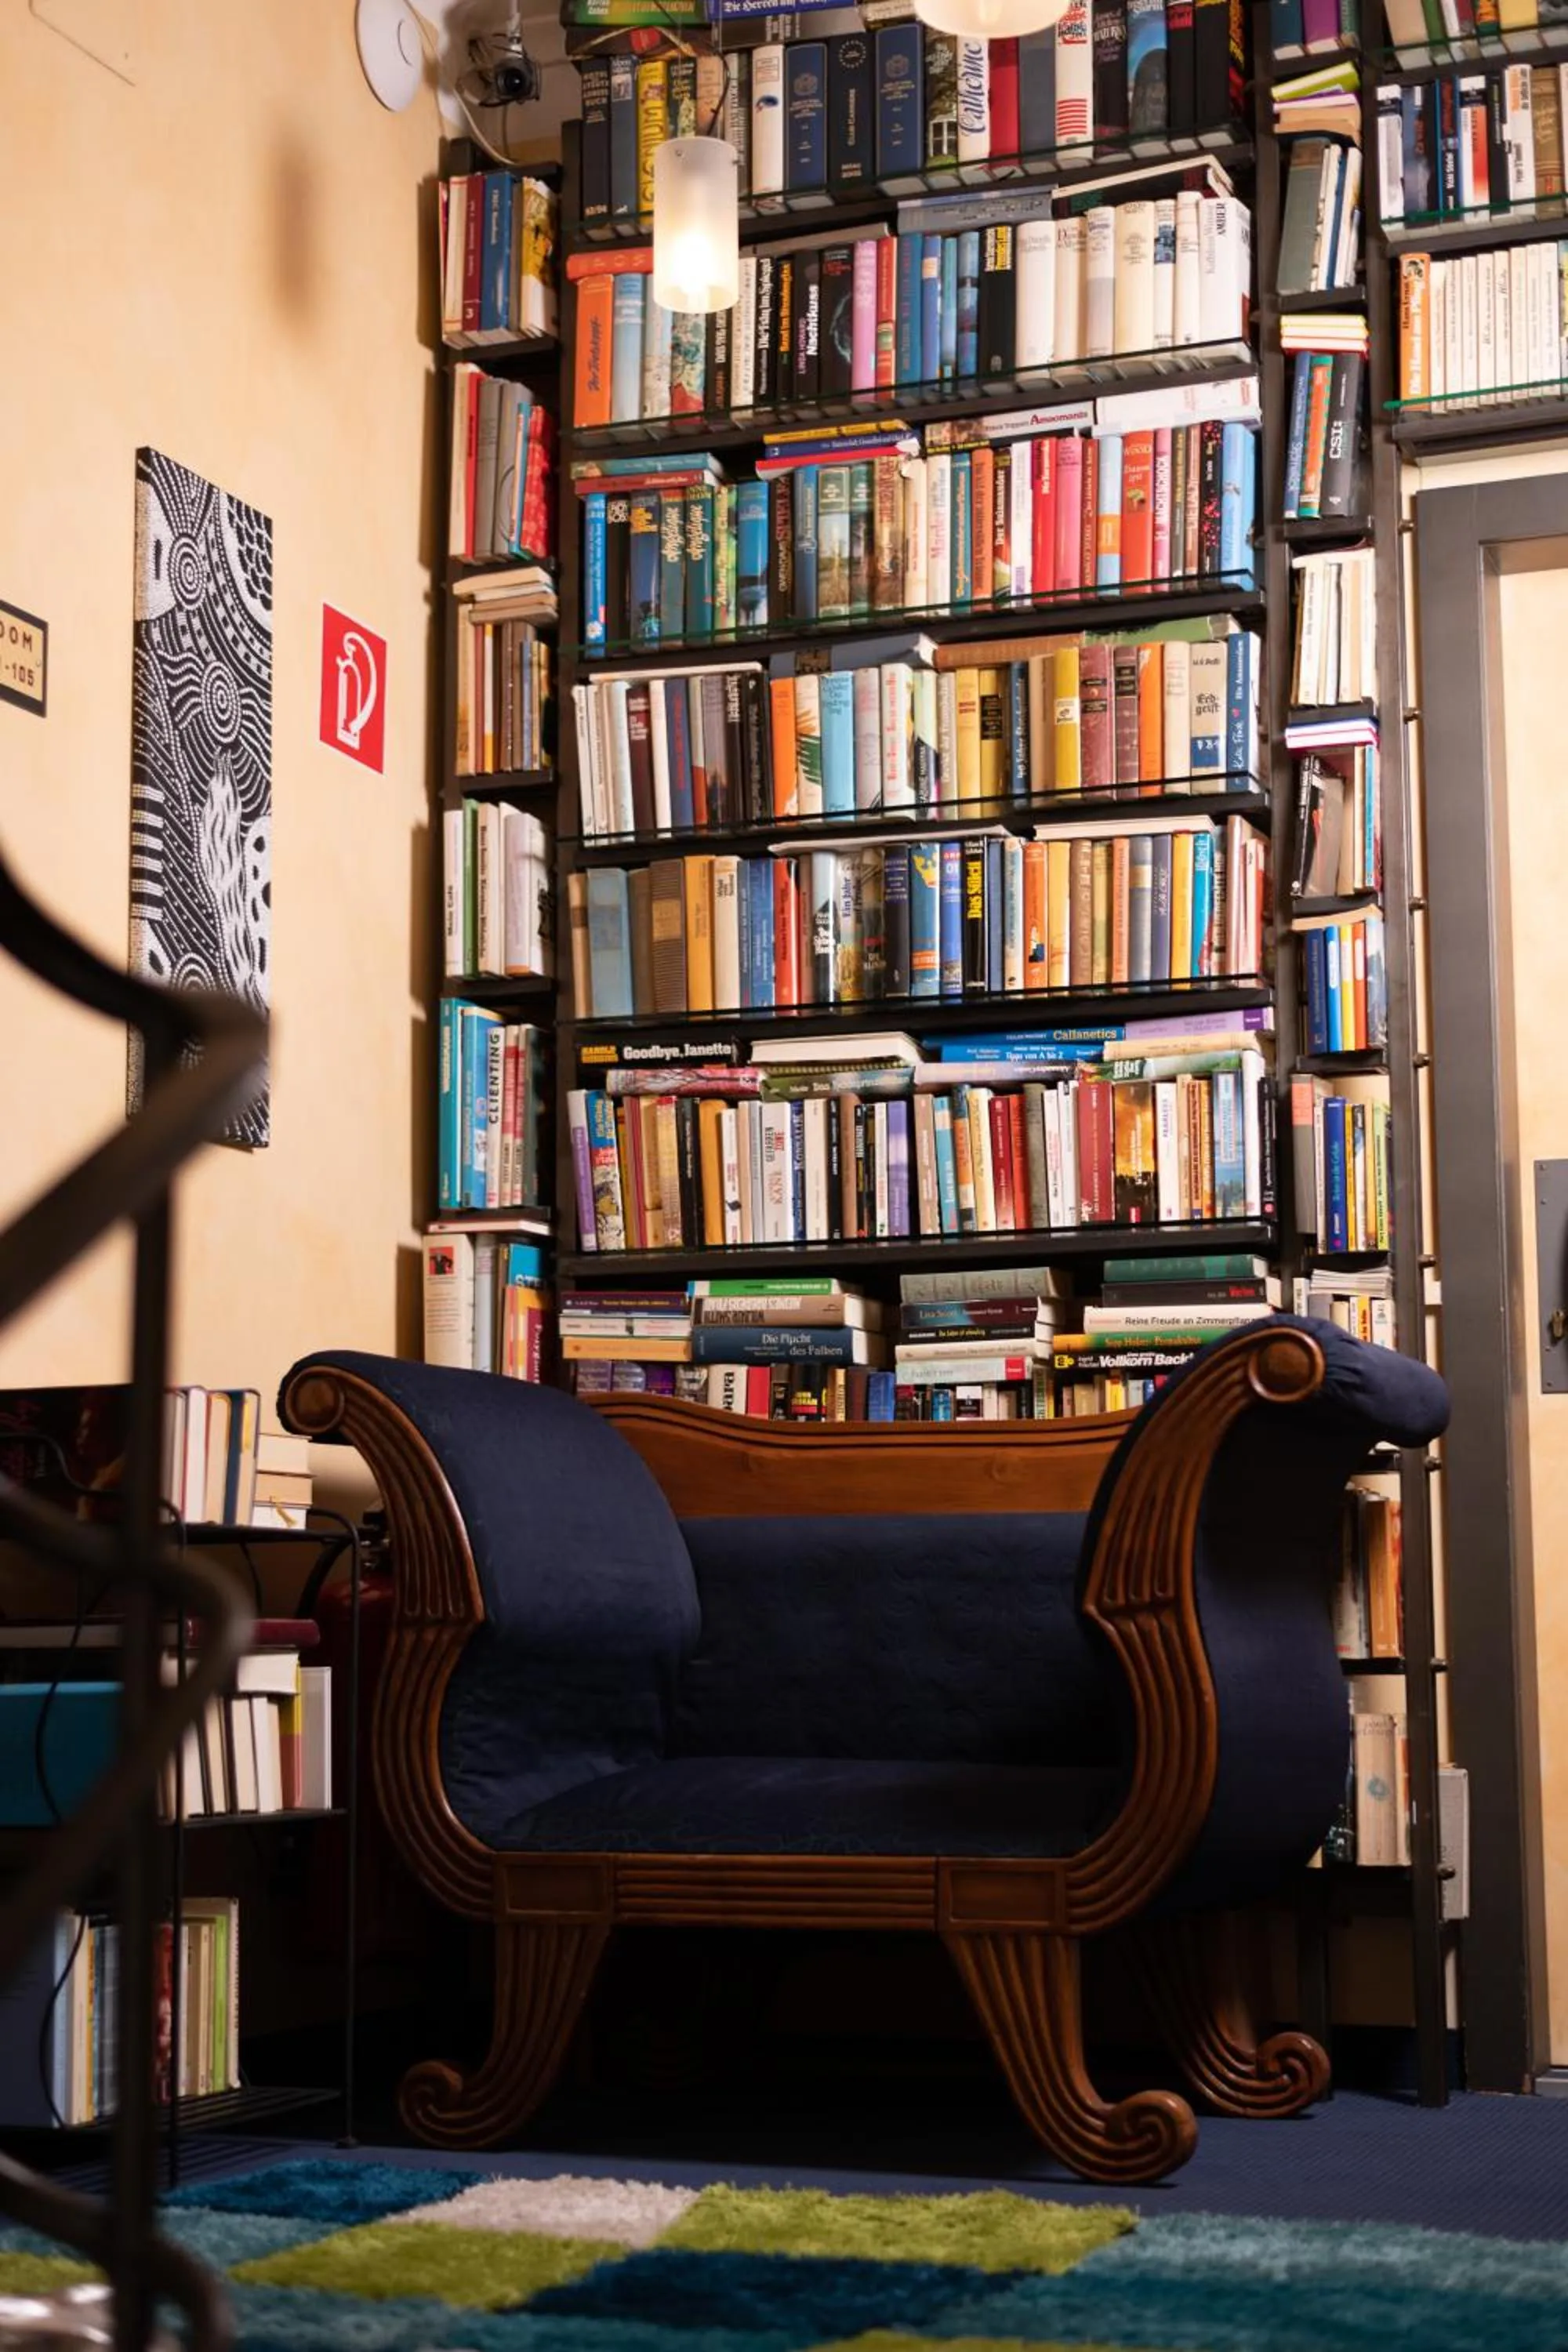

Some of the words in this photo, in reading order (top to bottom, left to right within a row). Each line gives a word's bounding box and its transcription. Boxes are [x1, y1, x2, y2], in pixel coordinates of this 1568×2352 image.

[805, 285, 818, 355] Nachtkuss
[1330, 420, 1343, 459] CSI:
[1053, 1029, 1116, 1041] Callanetics
[684, 1042, 731, 1056] Janette
[488, 1033, 500, 1125] CLIENTING
[1124, 1316, 1149, 1325] Reine
[1099, 1354, 1152, 1367] Vollkorn
[1153, 1352, 1194, 1366] Back
